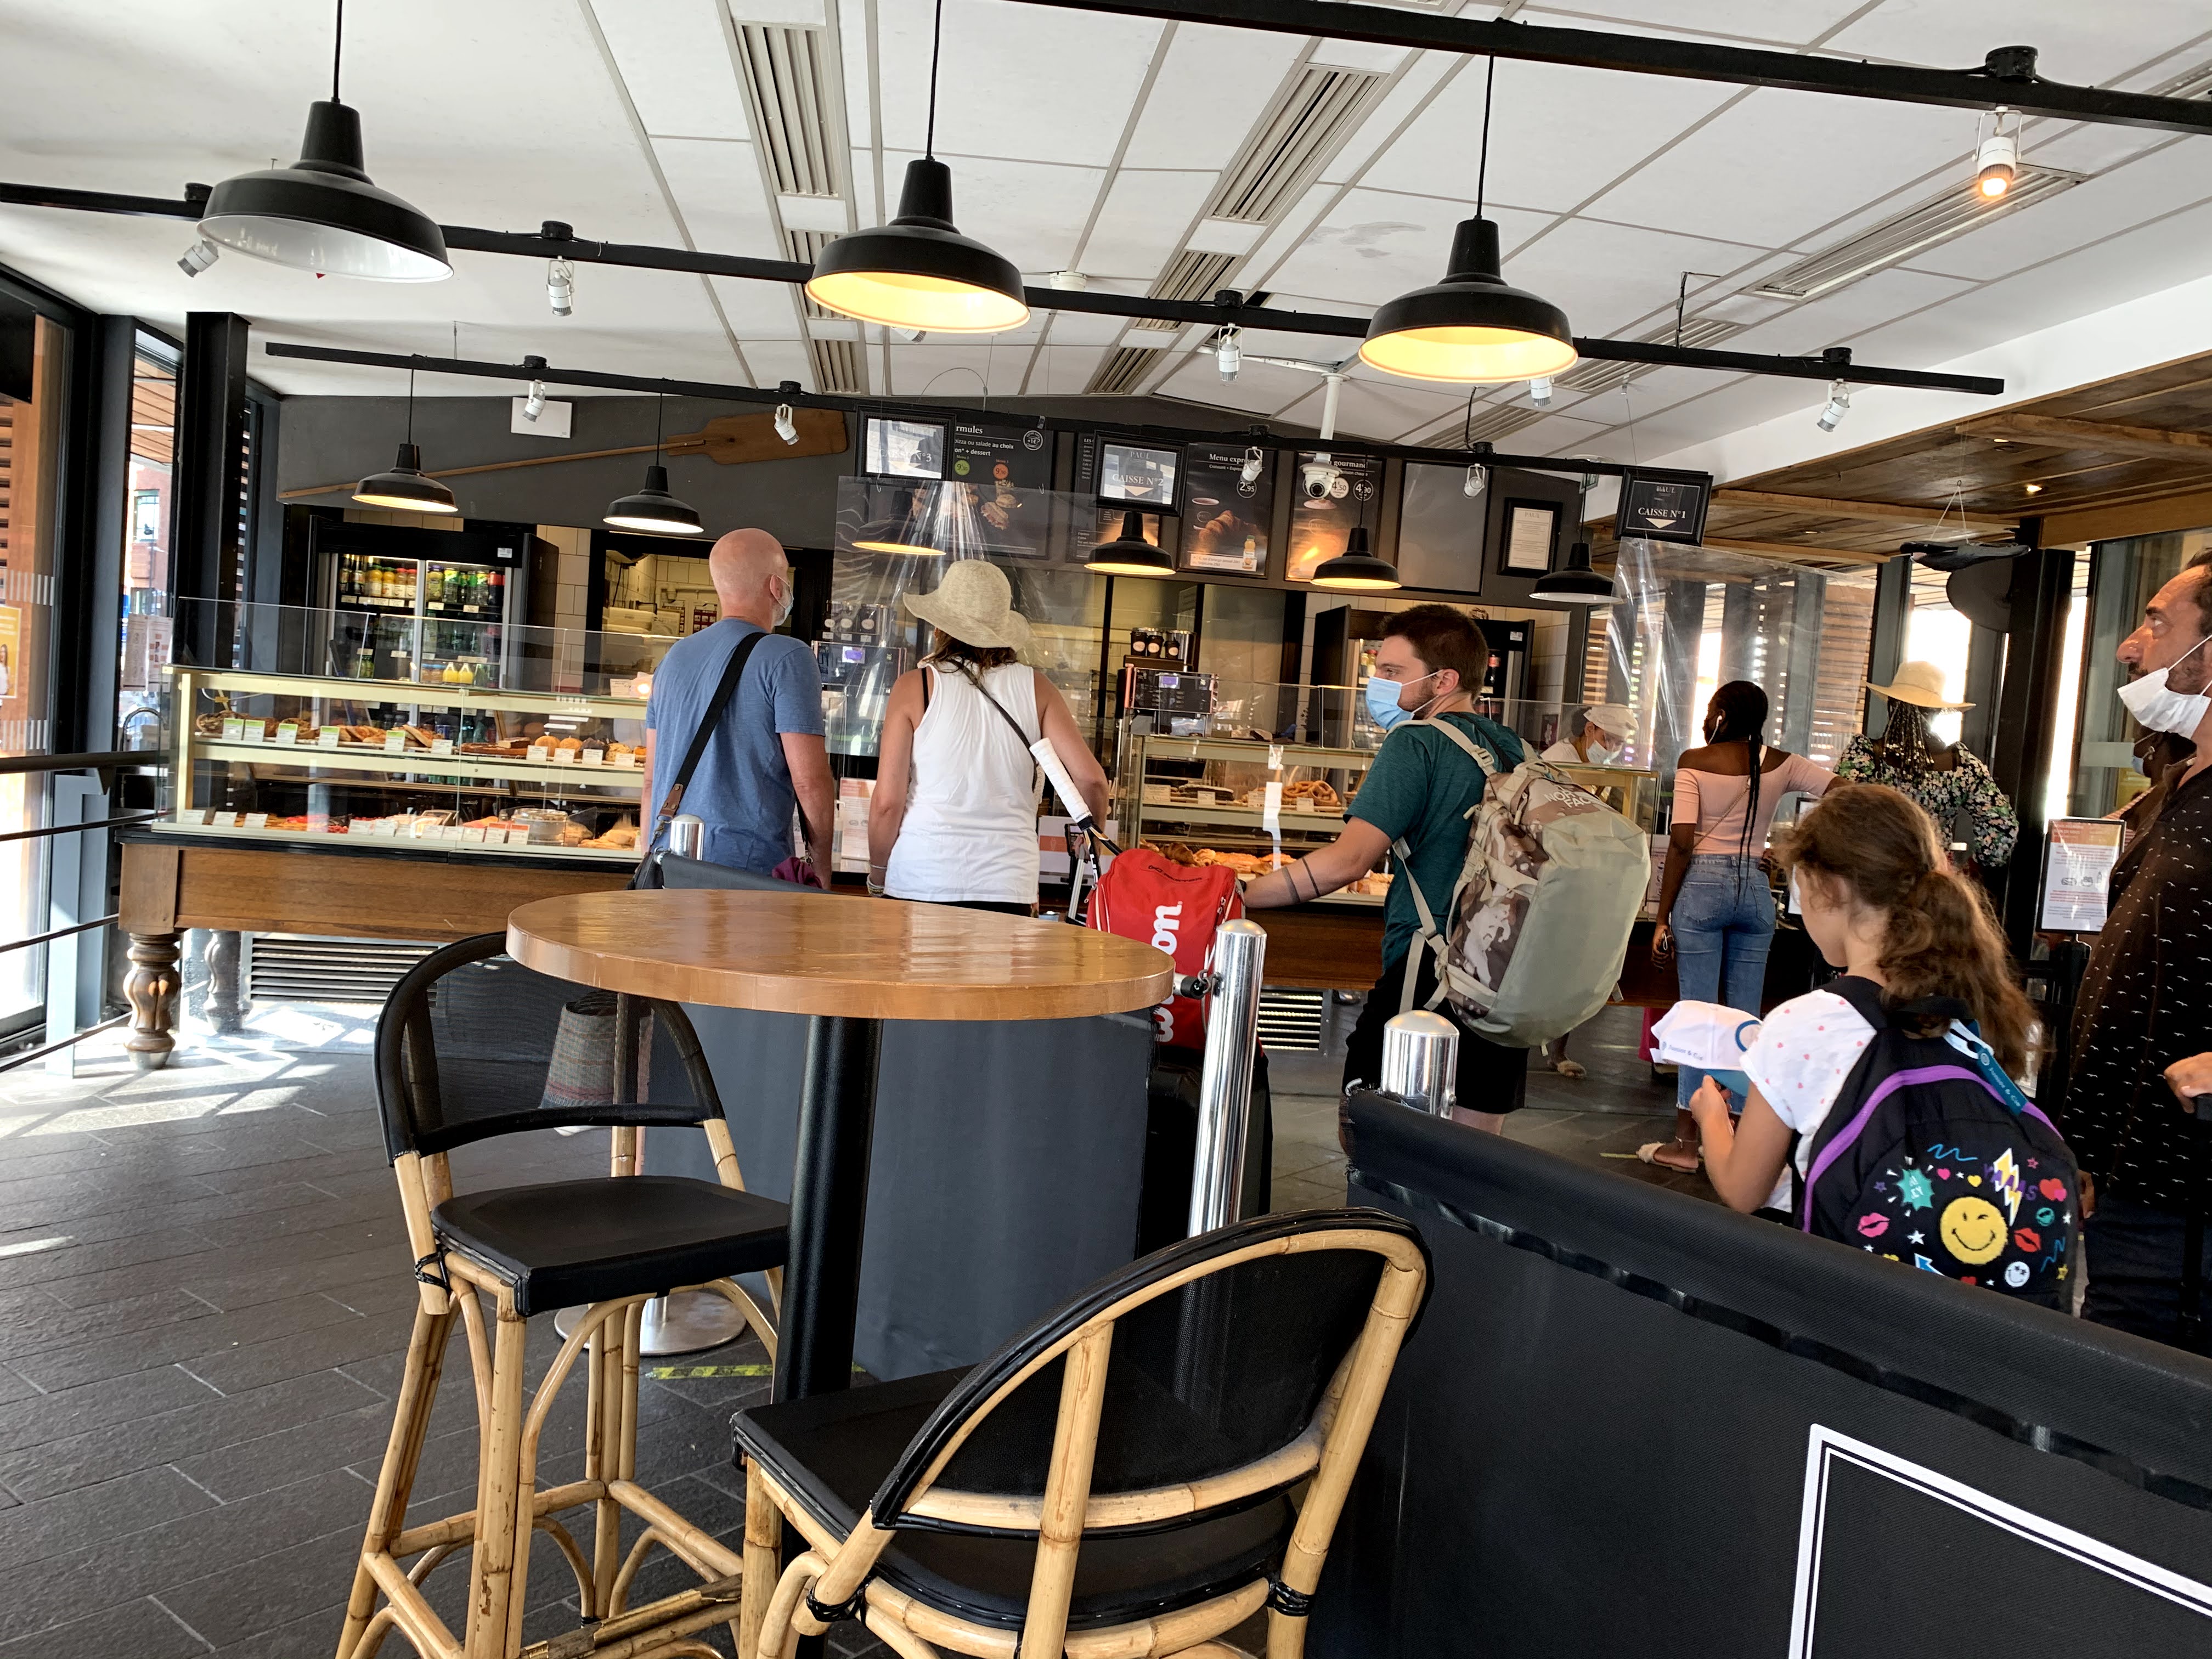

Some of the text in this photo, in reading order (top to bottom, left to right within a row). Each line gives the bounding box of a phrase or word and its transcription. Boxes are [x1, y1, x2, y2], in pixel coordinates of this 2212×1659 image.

[914, 453, 932, 462] N°3
[1130, 451, 1150, 459] PAUL
[1209, 453, 1228, 461] Menu
[1112, 473, 1164, 486] CAISSE N°2
[1638, 507, 1686, 519] CAISSE N°1
